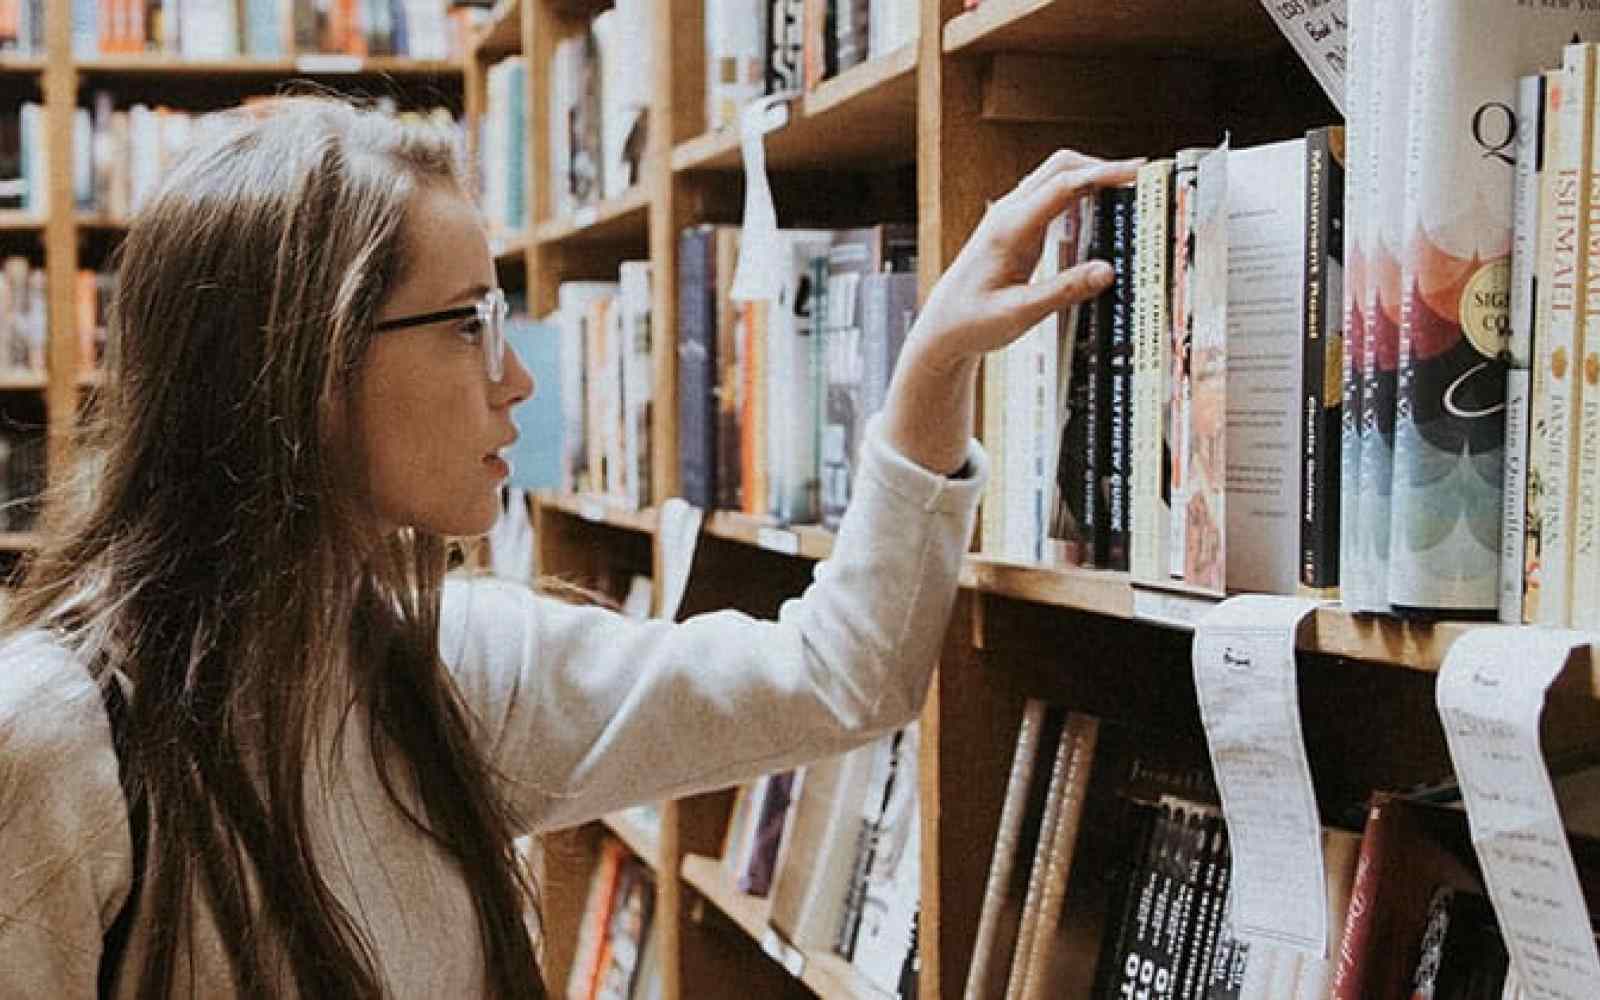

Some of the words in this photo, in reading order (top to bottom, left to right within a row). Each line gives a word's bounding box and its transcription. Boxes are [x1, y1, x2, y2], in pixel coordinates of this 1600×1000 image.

[1112, 203, 1126, 250] LOVE
[1307, 148, 1322, 273] Monument
[1551, 169, 1578, 324] ISHMAEL
[1111, 303, 1125, 346] FAIL
